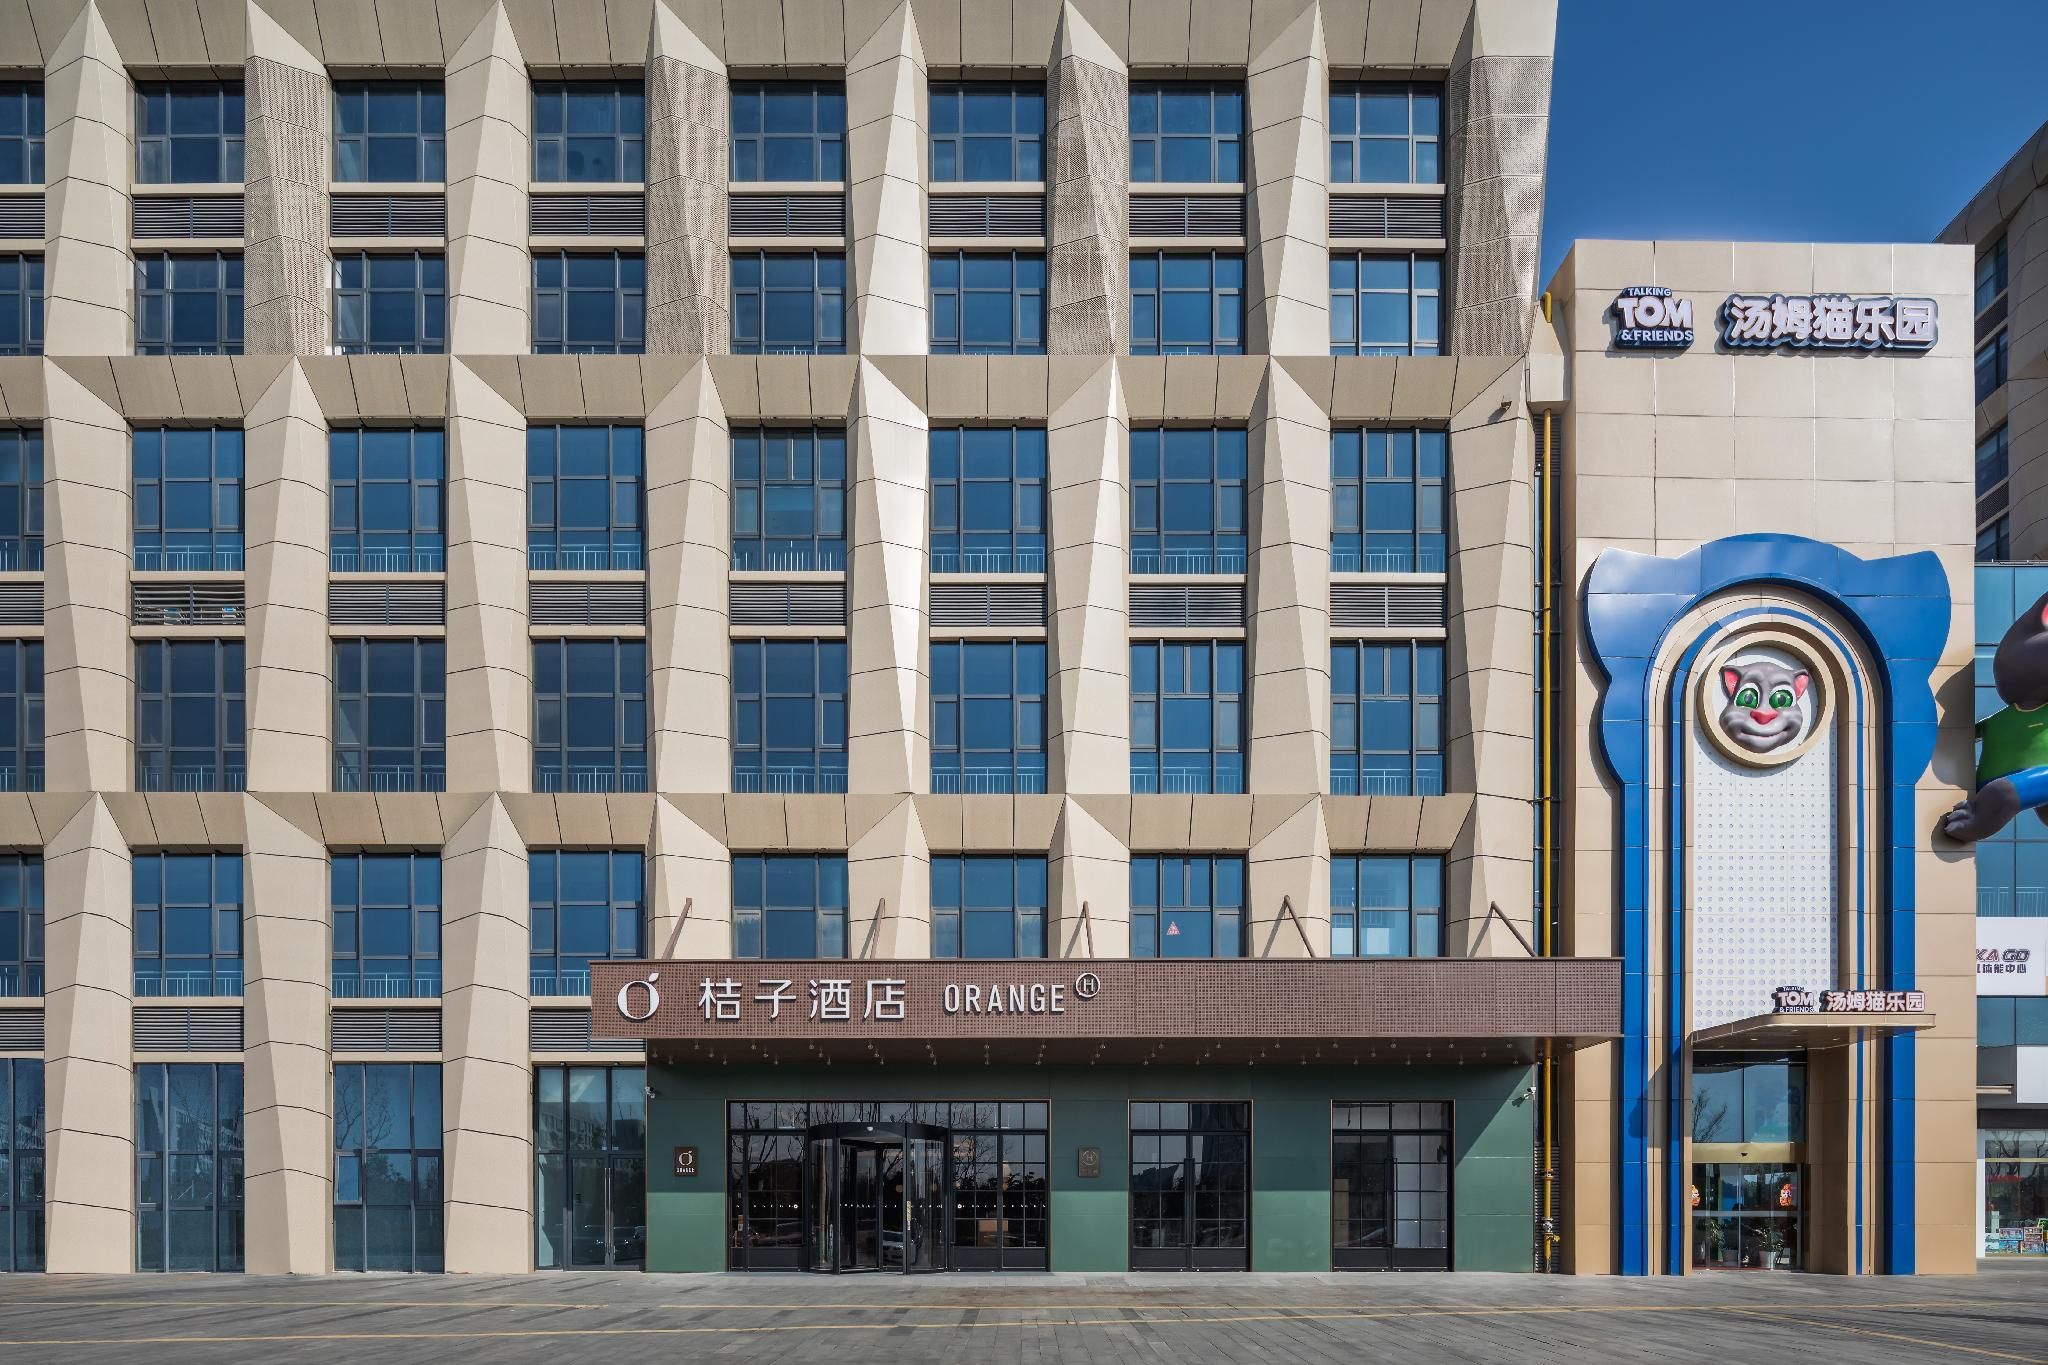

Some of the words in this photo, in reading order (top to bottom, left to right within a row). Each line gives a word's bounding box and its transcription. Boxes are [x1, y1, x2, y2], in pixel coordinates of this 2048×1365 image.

[1627, 287, 1672, 297] TALKING
[1617, 296, 1693, 329] TOM
[1730, 296, 1936, 342] 汤姆猫乐园
[698, 977, 906, 1019] 桔子酒店
[944, 983, 1066, 1013] ORANGE
[1777, 991, 1814, 1007] TOM
[1826, 990, 1925, 1012] 汤姆猫乐园
